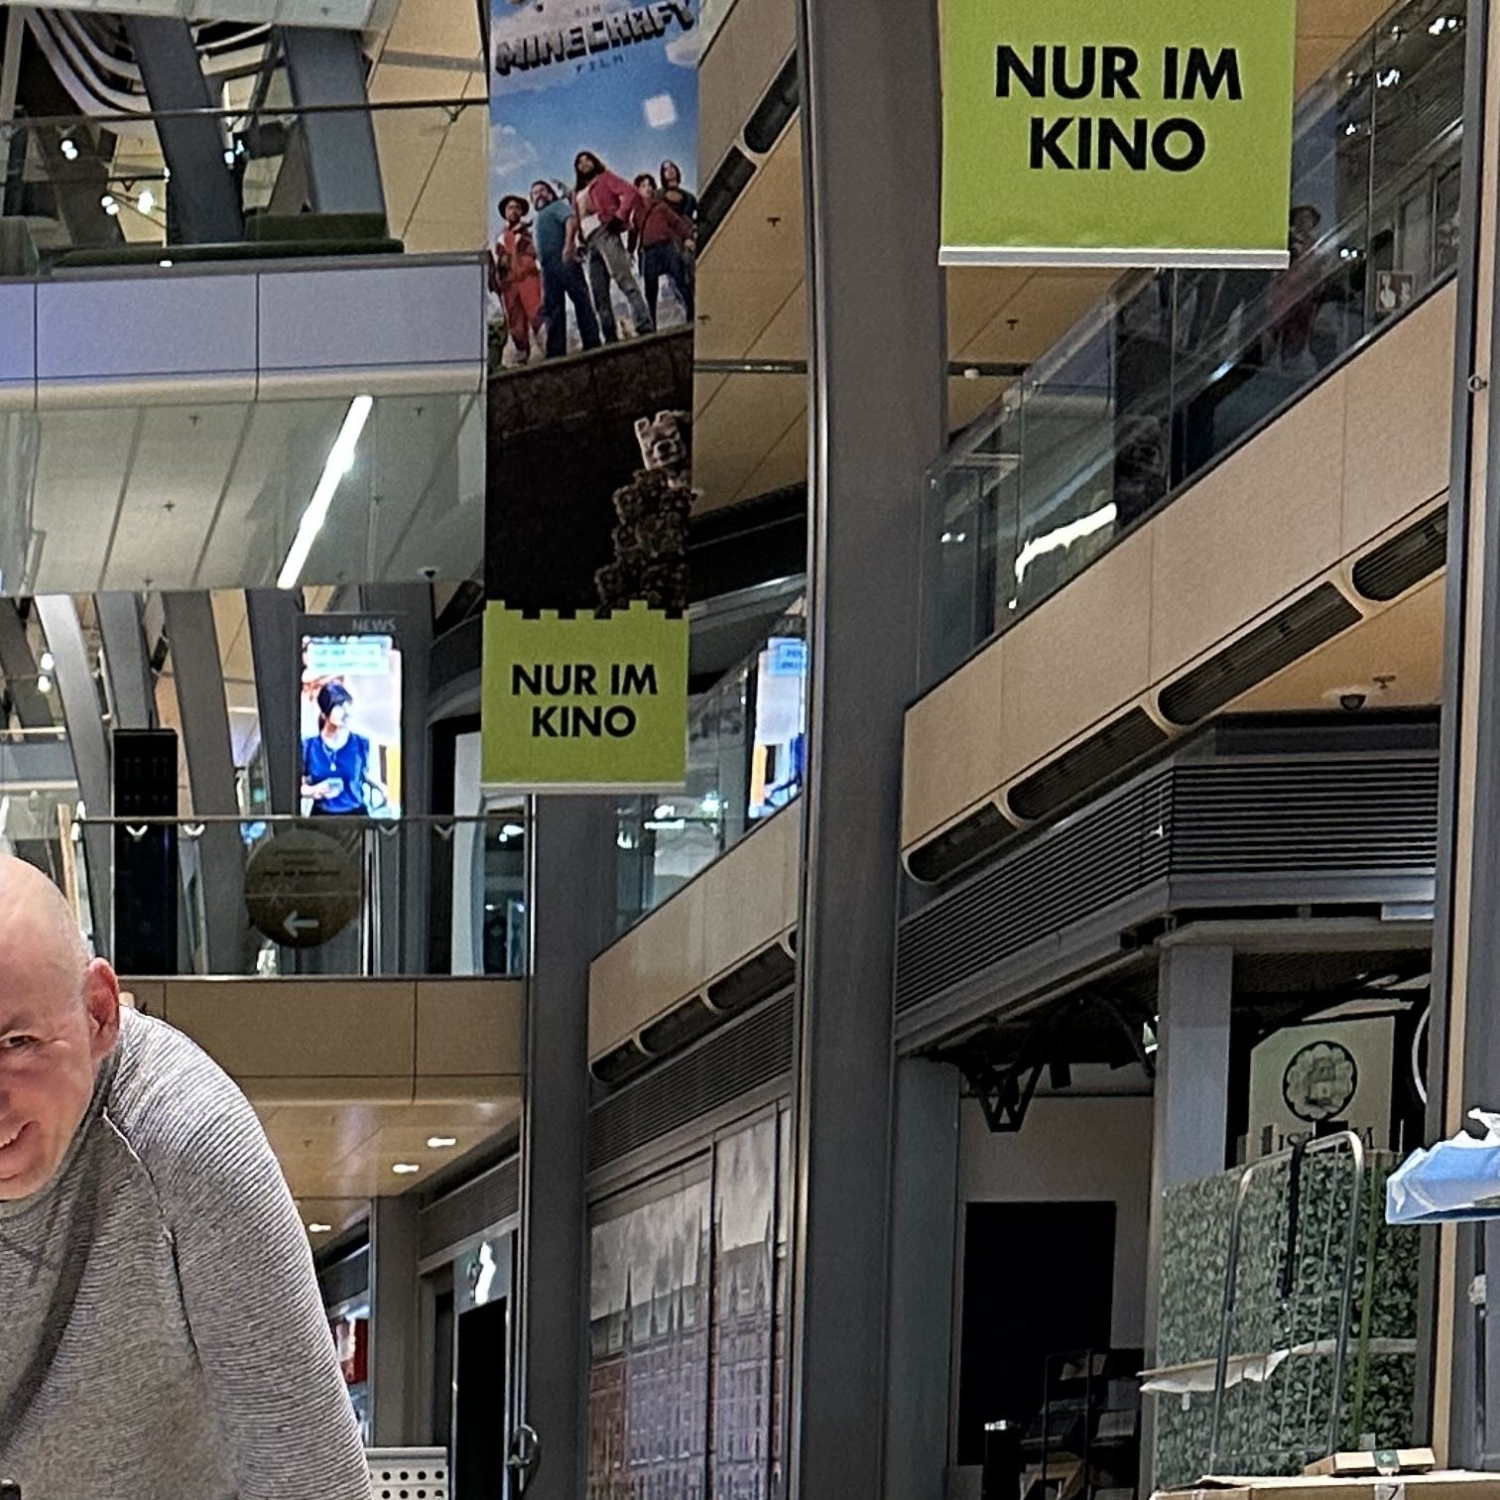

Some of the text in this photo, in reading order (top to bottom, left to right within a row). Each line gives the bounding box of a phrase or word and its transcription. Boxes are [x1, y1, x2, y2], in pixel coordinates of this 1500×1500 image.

[495, 1, 695, 76] MINECRAFT
[576, 54, 625, 74] FILM
[996, 45, 1242, 100] NUR IM
[1030, 117, 1206, 172] KINO
[352, 619, 397, 631] NEWS
[512, 664, 657, 695] NUR IM
[532, 706, 636, 737] KINO
